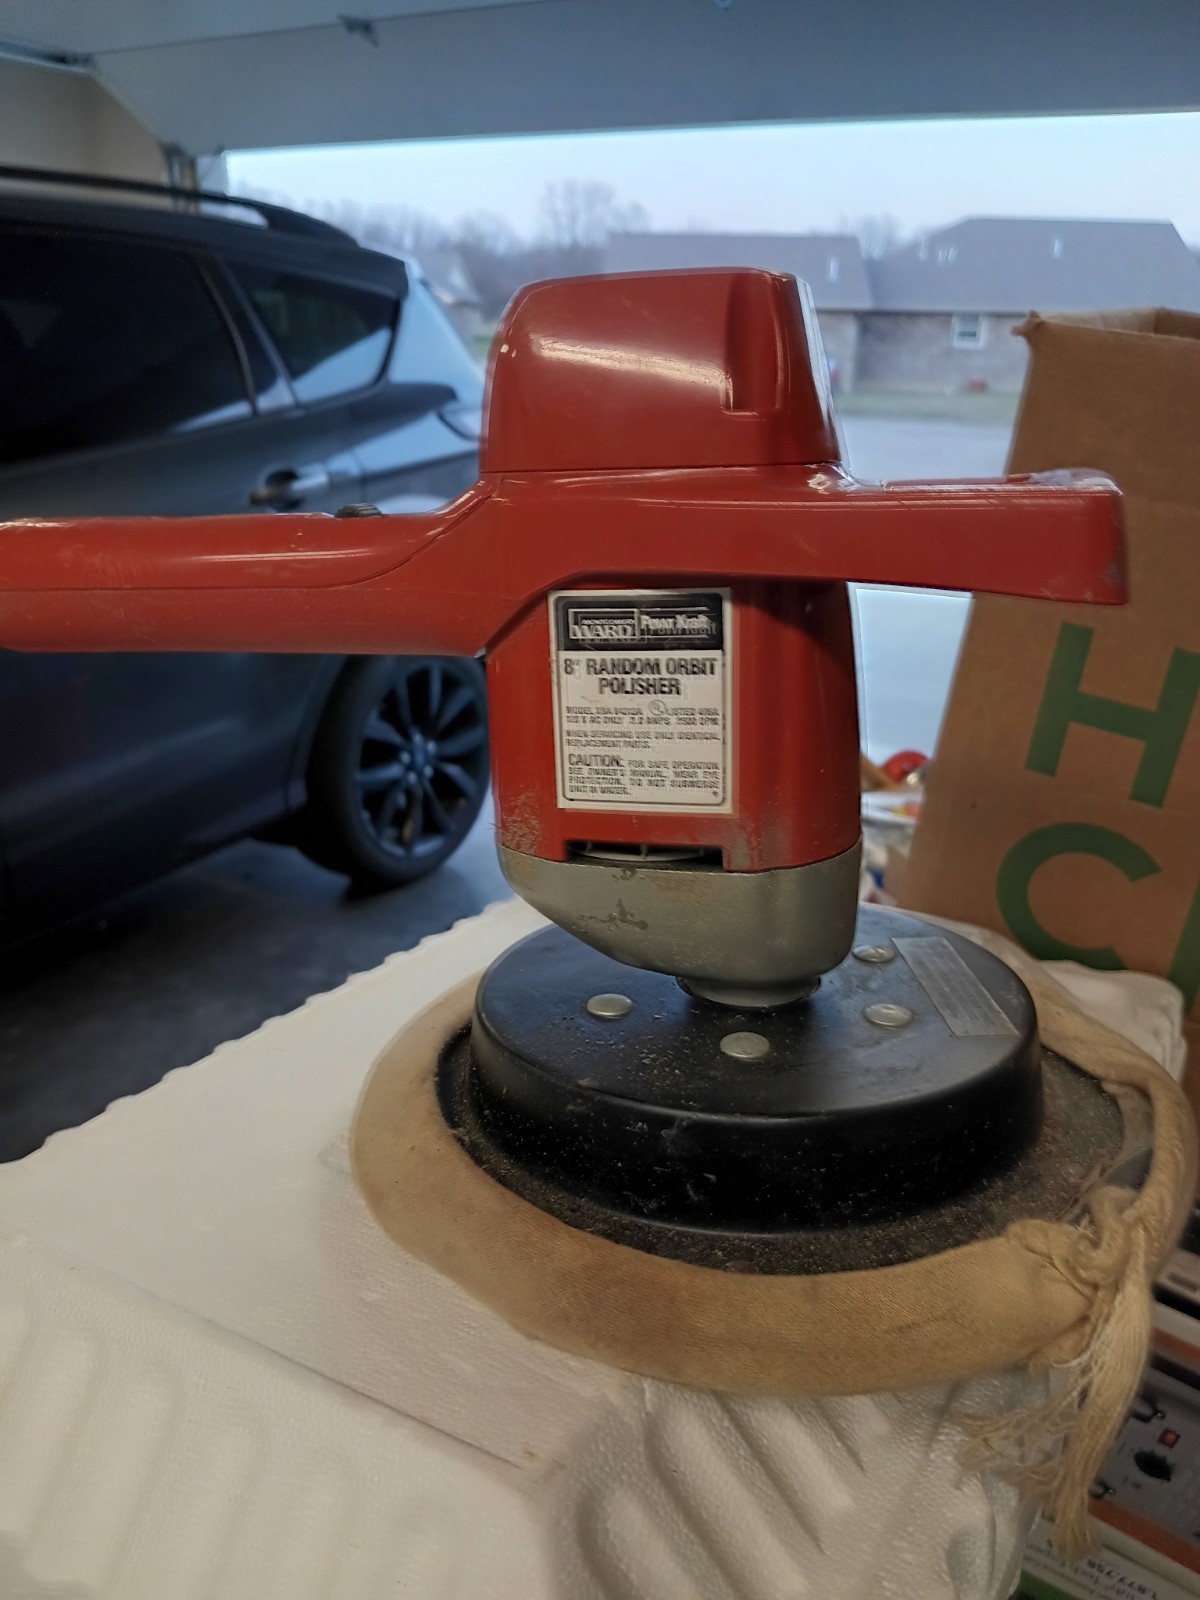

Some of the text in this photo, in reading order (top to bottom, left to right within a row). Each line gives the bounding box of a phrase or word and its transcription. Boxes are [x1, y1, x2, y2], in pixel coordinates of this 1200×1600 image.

[571, 625, 633, 638] WARD
[586, 658, 661, 675] RANDOM
[666, 658, 718, 675] ORBIT
[599, 677, 681, 695] POLISHER
[568, 754, 625, 767] CAUTION:
